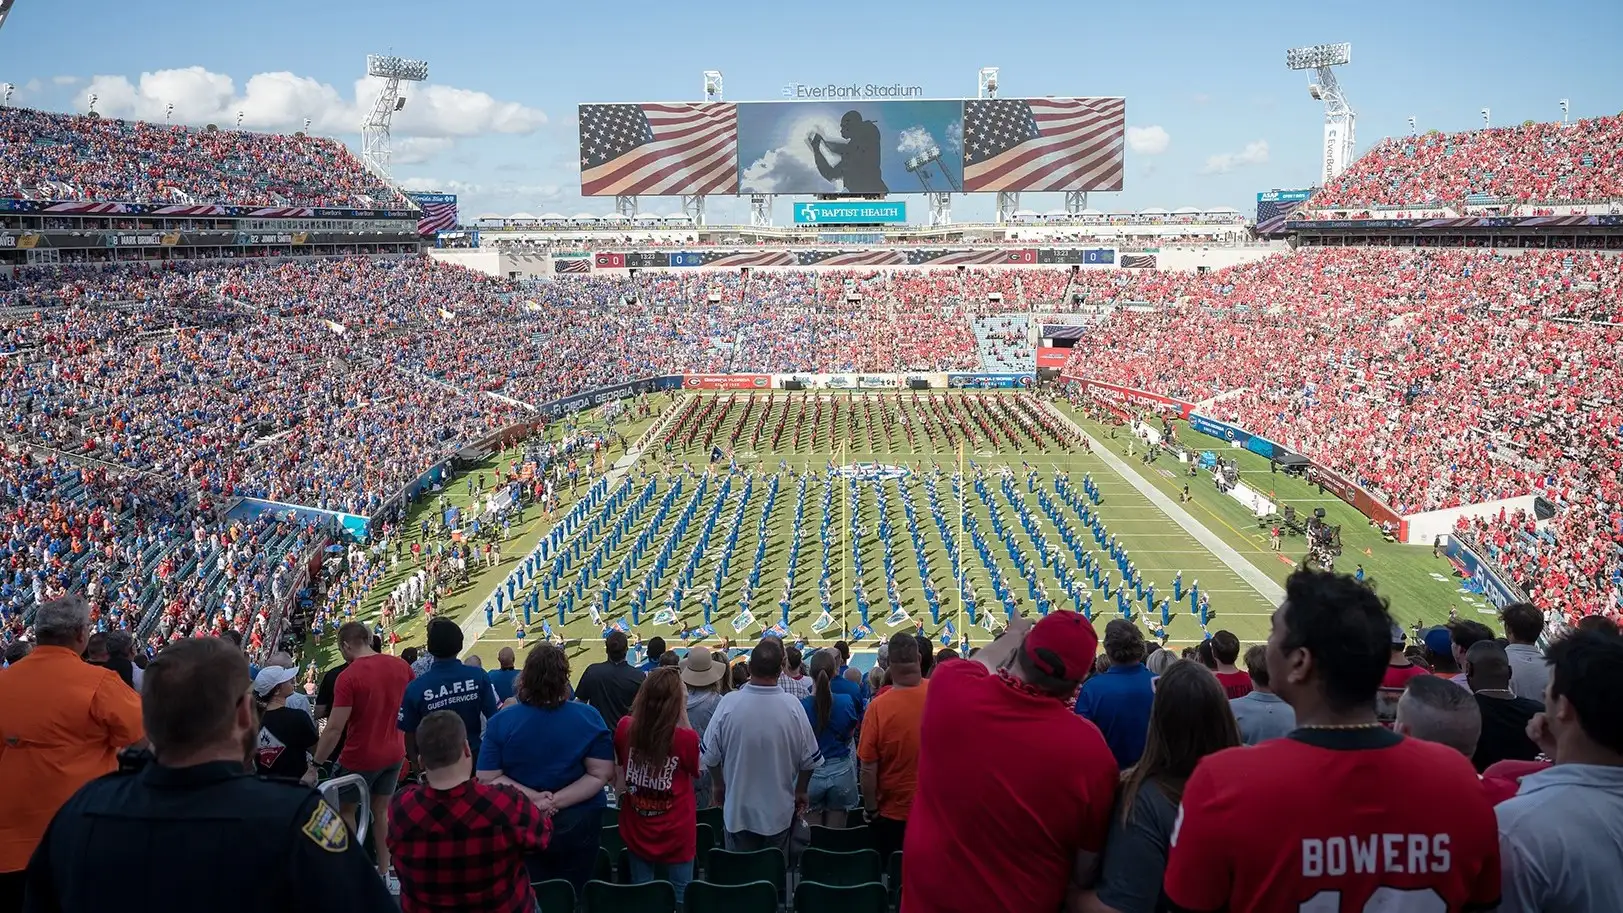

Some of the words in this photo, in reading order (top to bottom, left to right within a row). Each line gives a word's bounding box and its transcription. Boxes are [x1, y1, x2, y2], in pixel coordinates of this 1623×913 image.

[797, 83, 861, 98] EverBank
[865, 83, 923, 97] Stadium
[821, 208, 859, 217] BAPTIST
[860, 208, 898, 217] HEALTH
[121, 235, 137, 245] MARK
[612, 256, 619, 265] 0
[676, 255, 683, 264] 0
[1024, 252, 1031, 261] 0
[1090, 252, 1097, 261] 0
[1087, 383, 1126, 401] GEORGIA
[553, 397, 590, 415] FLORIDA
[595, 386, 634, 404] GEORGIA
[423, 679, 479, 701] S.A.F.E.
[427, 699, 448, 711] GUEST
[448, 692, 479, 705] SERVICES
[625, 771, 673, 791] FRIENDS
[1302, 833, 1451, 877] BOWERS
